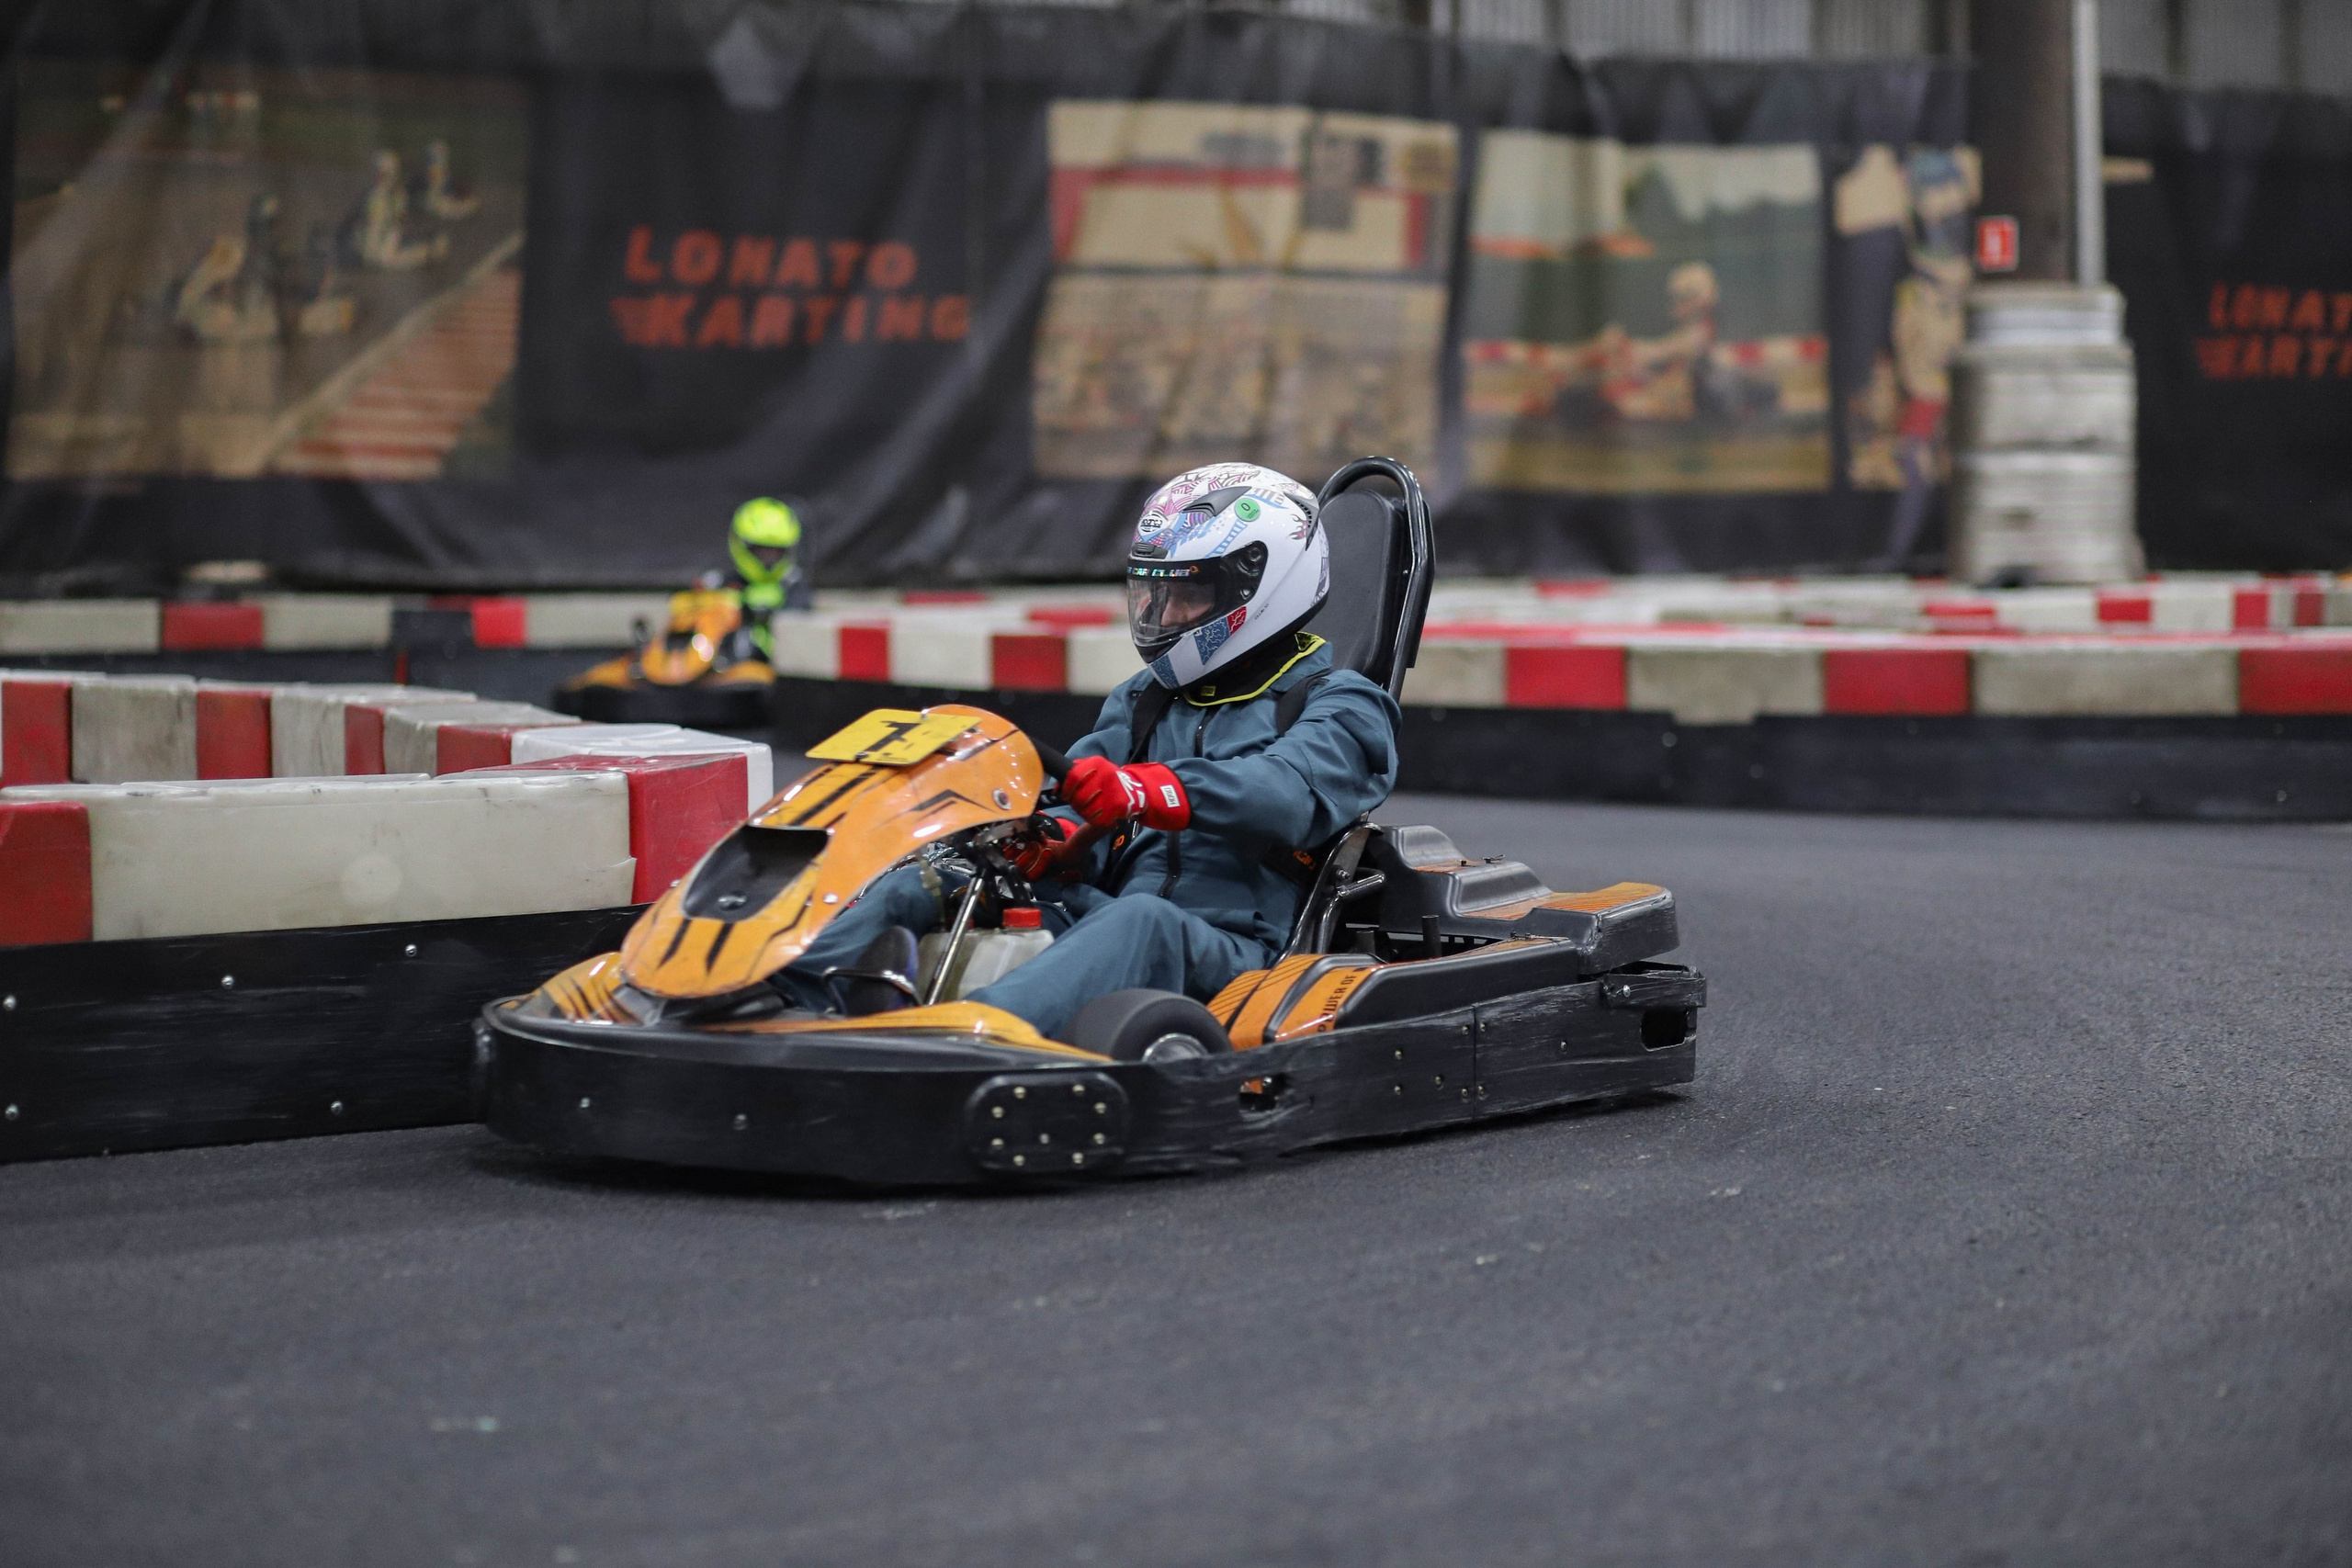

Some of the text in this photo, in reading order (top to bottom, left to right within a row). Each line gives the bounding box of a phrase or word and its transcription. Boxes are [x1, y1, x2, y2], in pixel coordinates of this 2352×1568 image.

[623, 225, 918, 290] LONATO
[610, 292, 972, 347] KARTING
[1151, 568, 1191, 578] CLUB
[1340, 976, 1357, 986] OF
